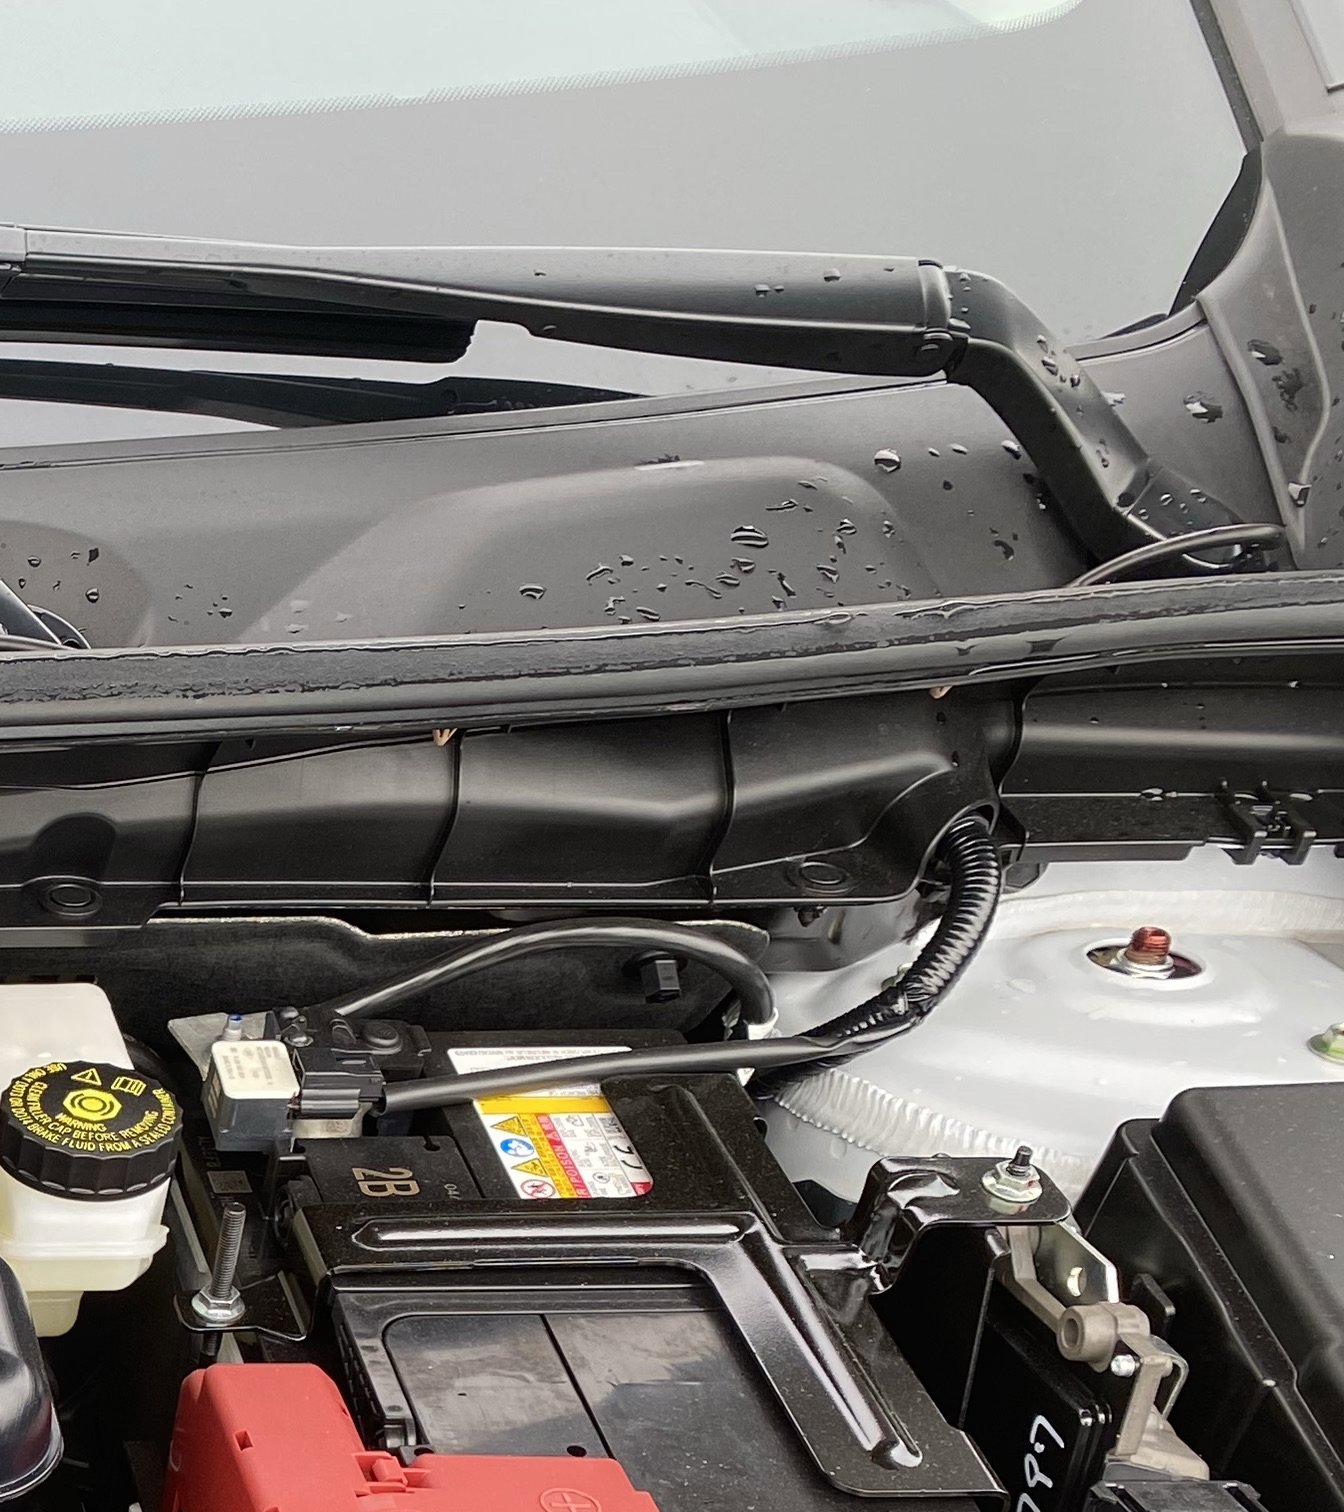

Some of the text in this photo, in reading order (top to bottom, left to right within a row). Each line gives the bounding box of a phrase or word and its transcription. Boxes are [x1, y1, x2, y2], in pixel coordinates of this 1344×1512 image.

[48, 1118, 72, 1135] CAP
[72, 1129, 120, 1142] BEFORE
[55, 1112, 108, 1133] WARNING
[27, 1123, 61, 1144] BRAKE
[62, 1137, 96, 1151] FLUID
[99, 1142, 132, 1152] FROM
[132, 1140, 142, 1149] A
[352, 1167, 420, 1197] 2B
